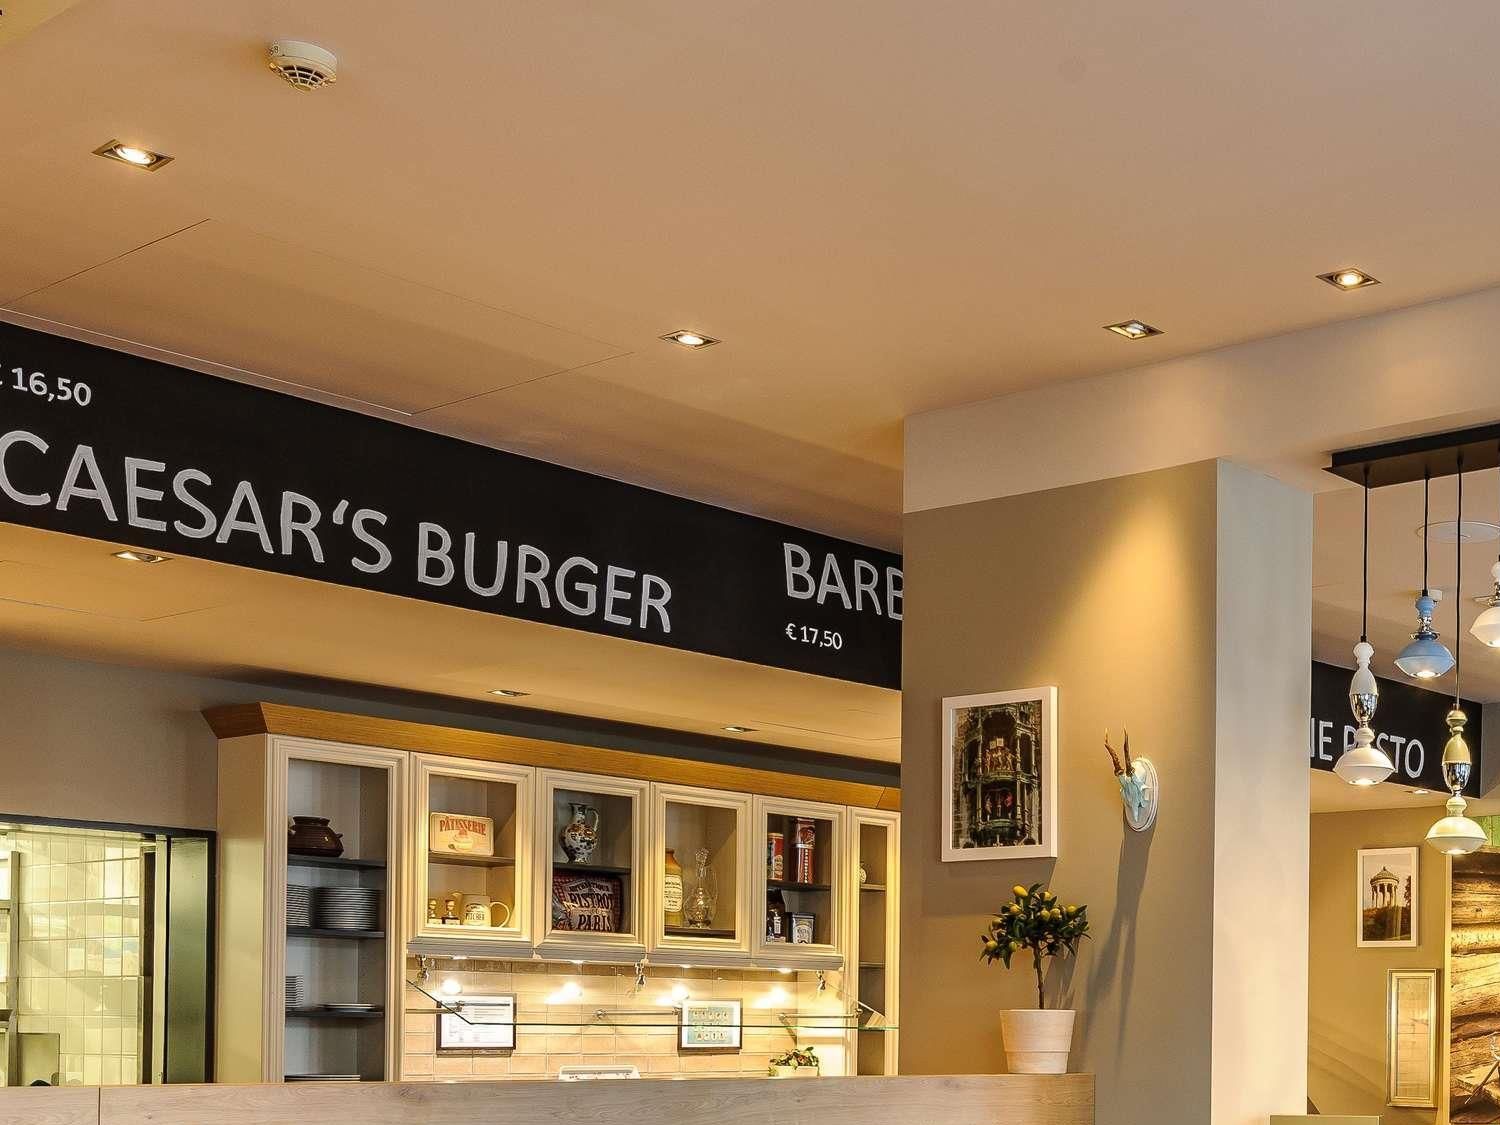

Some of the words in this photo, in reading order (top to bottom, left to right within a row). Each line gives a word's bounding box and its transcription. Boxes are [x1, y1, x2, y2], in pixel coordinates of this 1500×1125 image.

[11, 367, 92, 406] 16,50
[417, 521, 672, 633] BURGER
[800, 625, 843, 650] 17,50
[1343, 725, 1425, 779] PSTO
